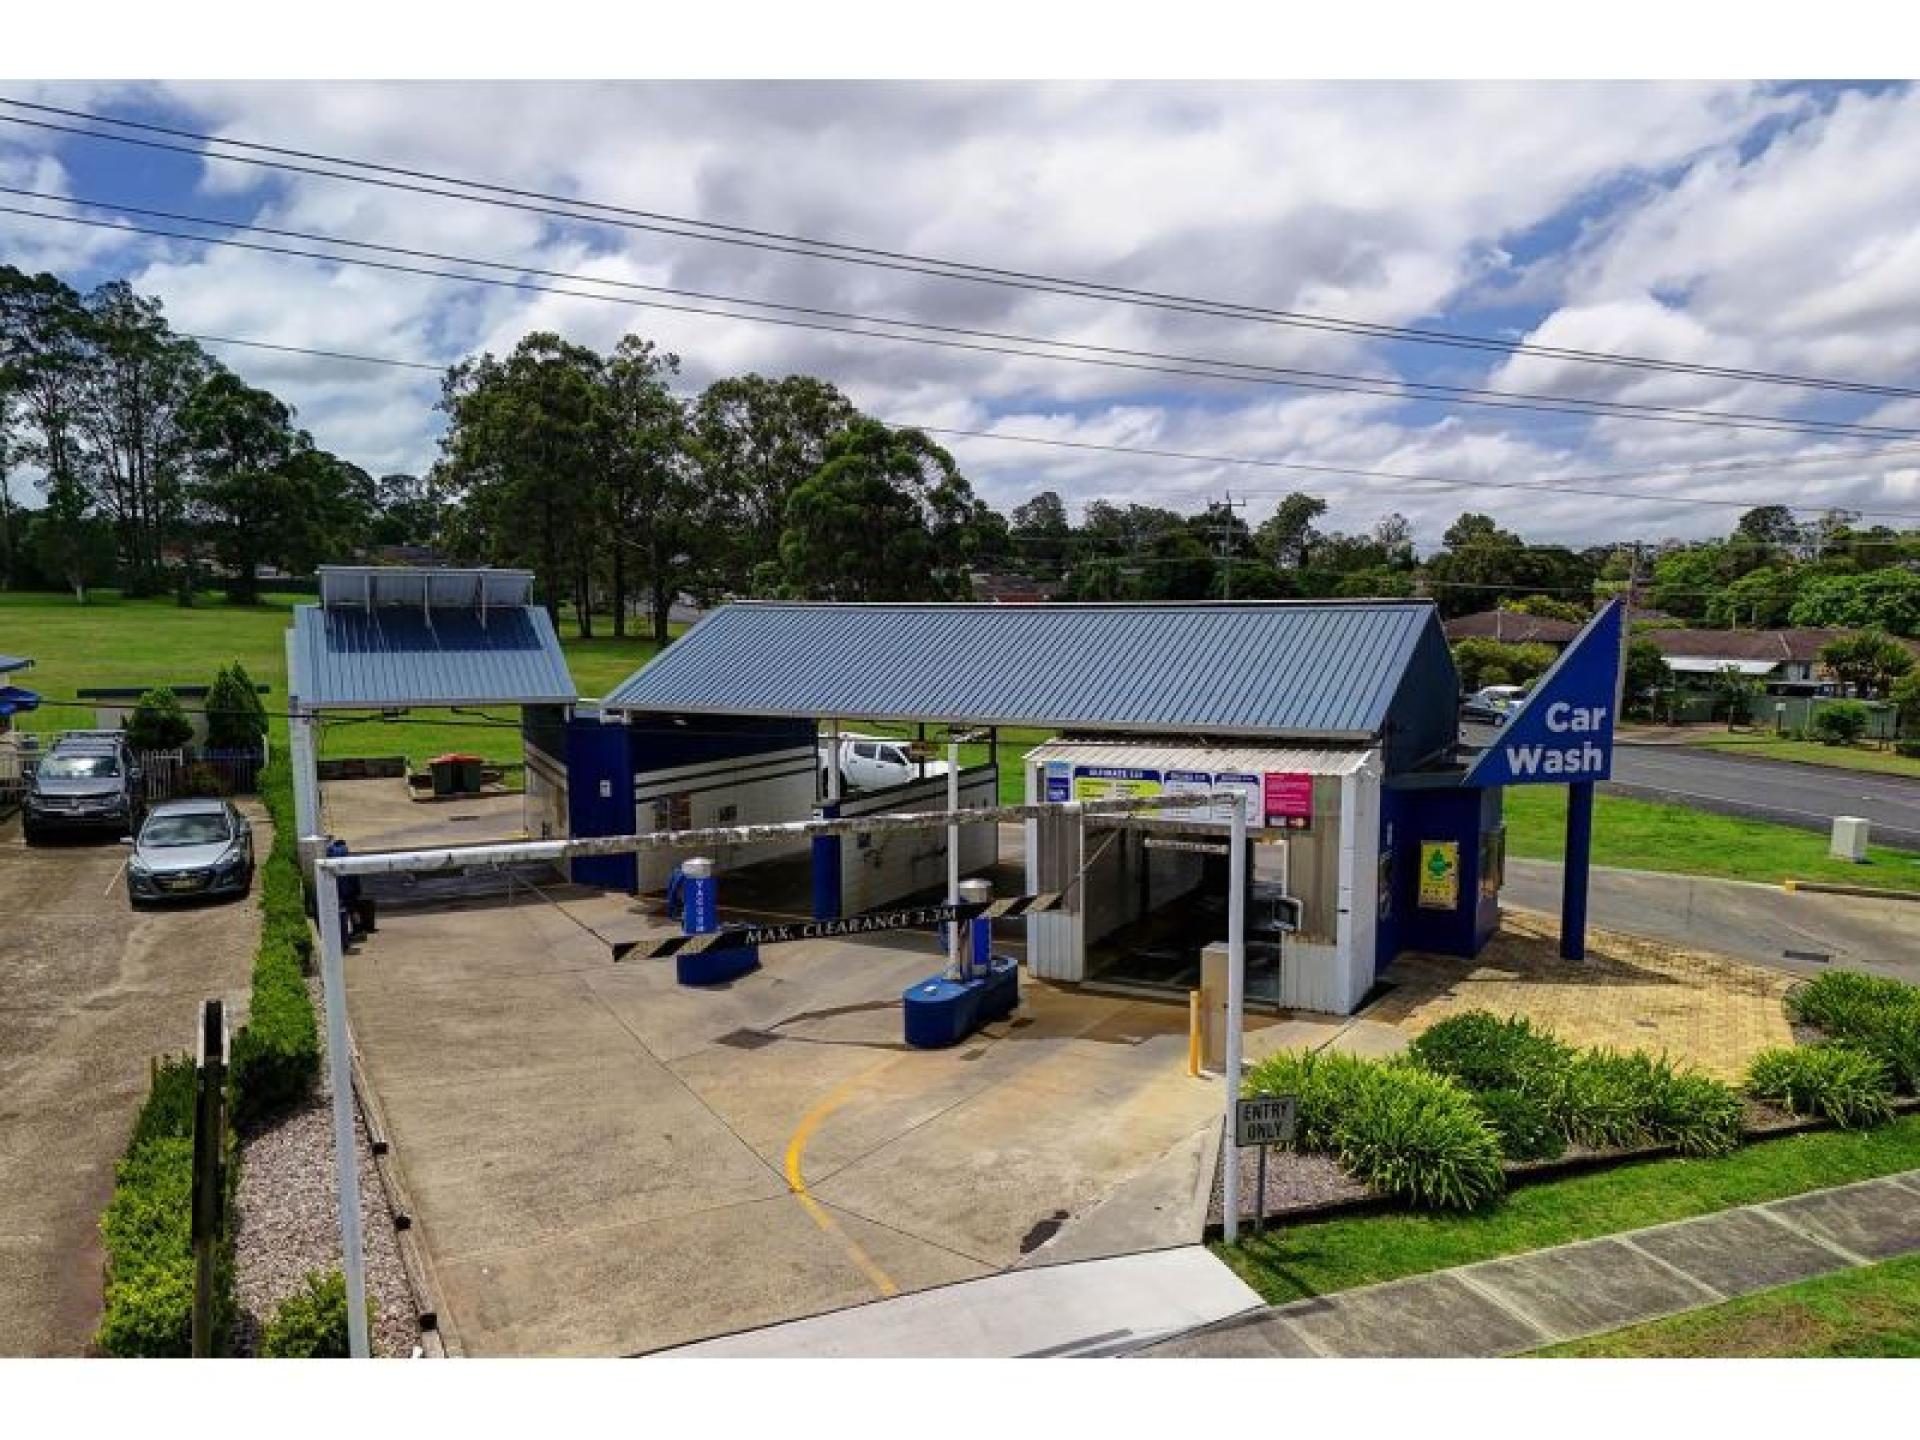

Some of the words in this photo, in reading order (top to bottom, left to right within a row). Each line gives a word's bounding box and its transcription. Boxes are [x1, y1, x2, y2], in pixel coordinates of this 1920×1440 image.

[1546, 702, 1607, 732] Car
[1506, 741, 1603, 776] Wash
[803, 910, 909, 938] CLEARANCE
[1243, 1102, 1289, 1121] ENTRY
[1247, 1121, 1282, 1139] ONLY
